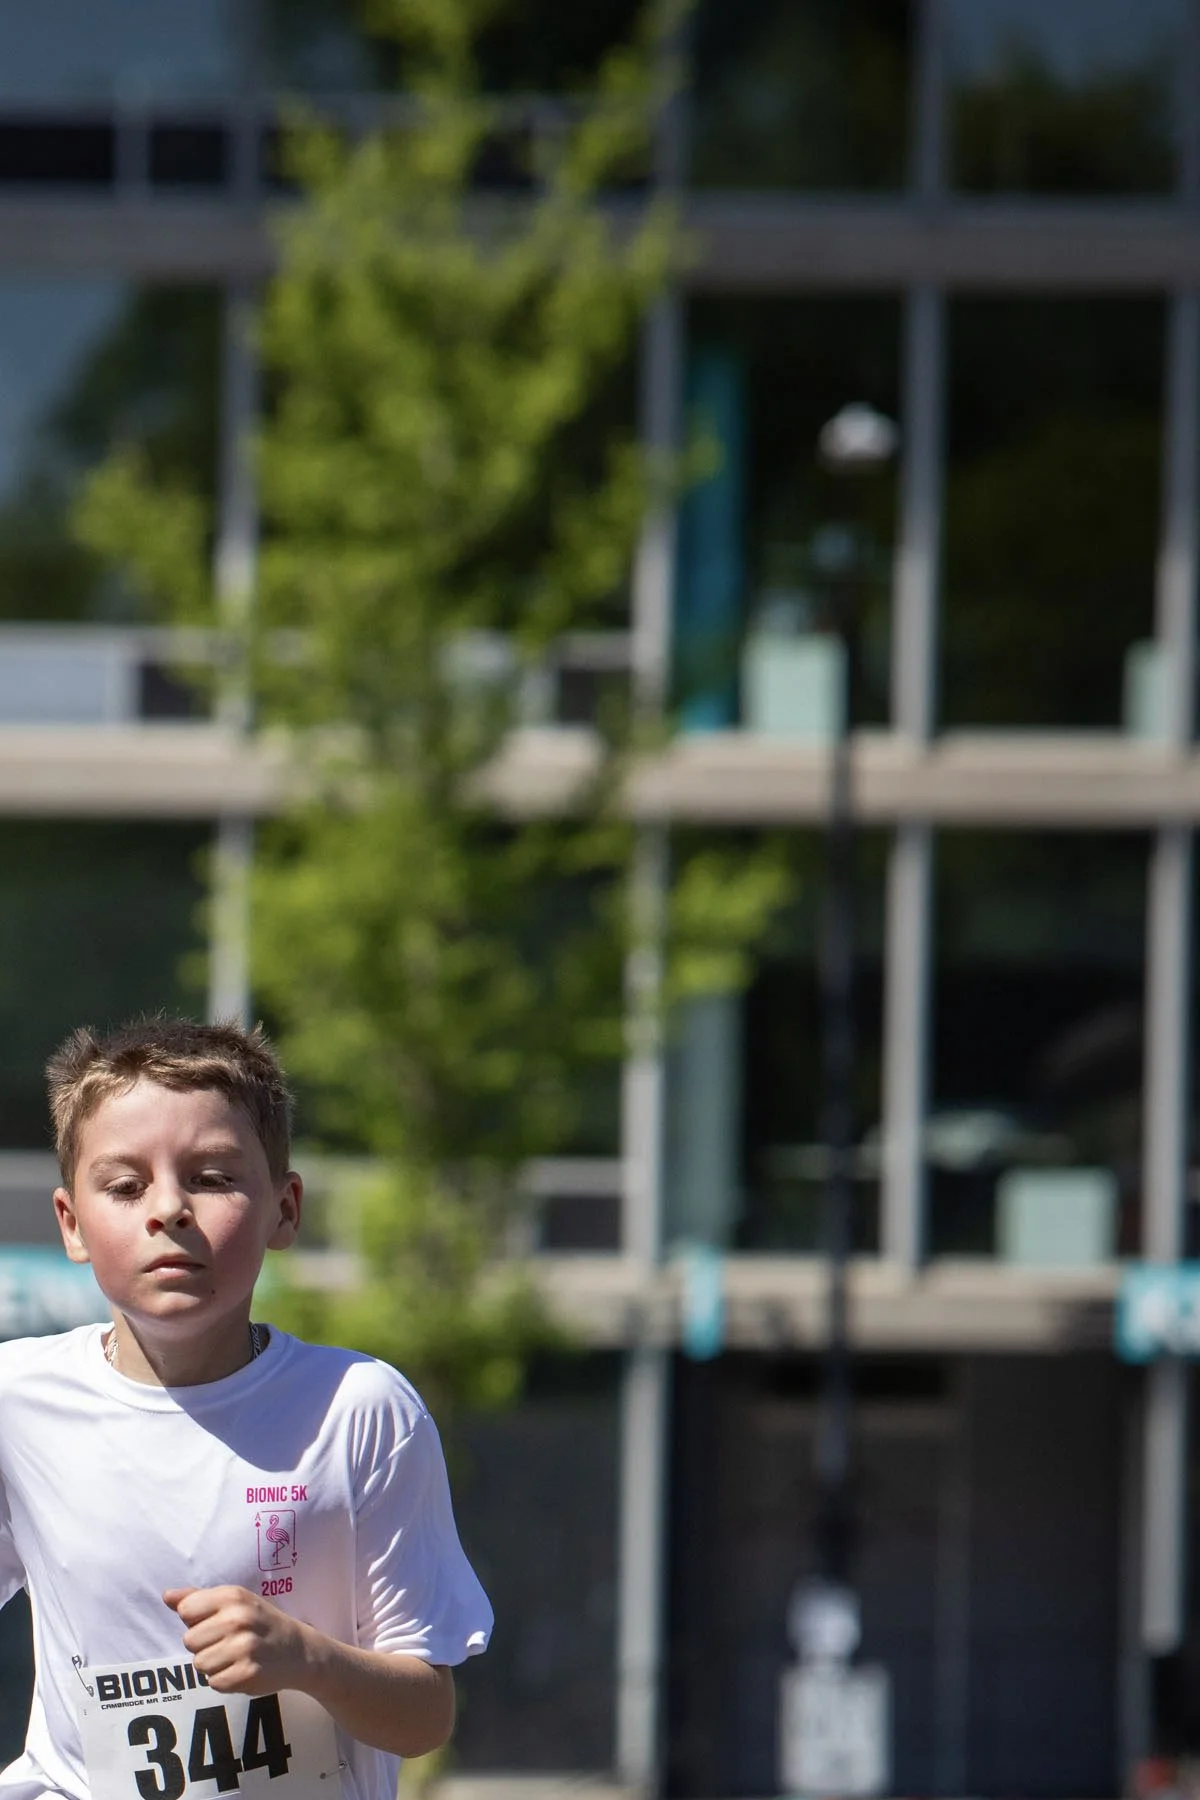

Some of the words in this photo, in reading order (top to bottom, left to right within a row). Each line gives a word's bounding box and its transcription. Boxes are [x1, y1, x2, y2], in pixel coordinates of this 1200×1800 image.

[246, 1486, 288, 1503] BIONIC
[291, 1485, 307, 1501] 5K
[261, 1577, 293, 1596] 2026
[101, 1700, 145, 1710] CAMBRIDGE
[162, 1694, 183, 1703] 2026
